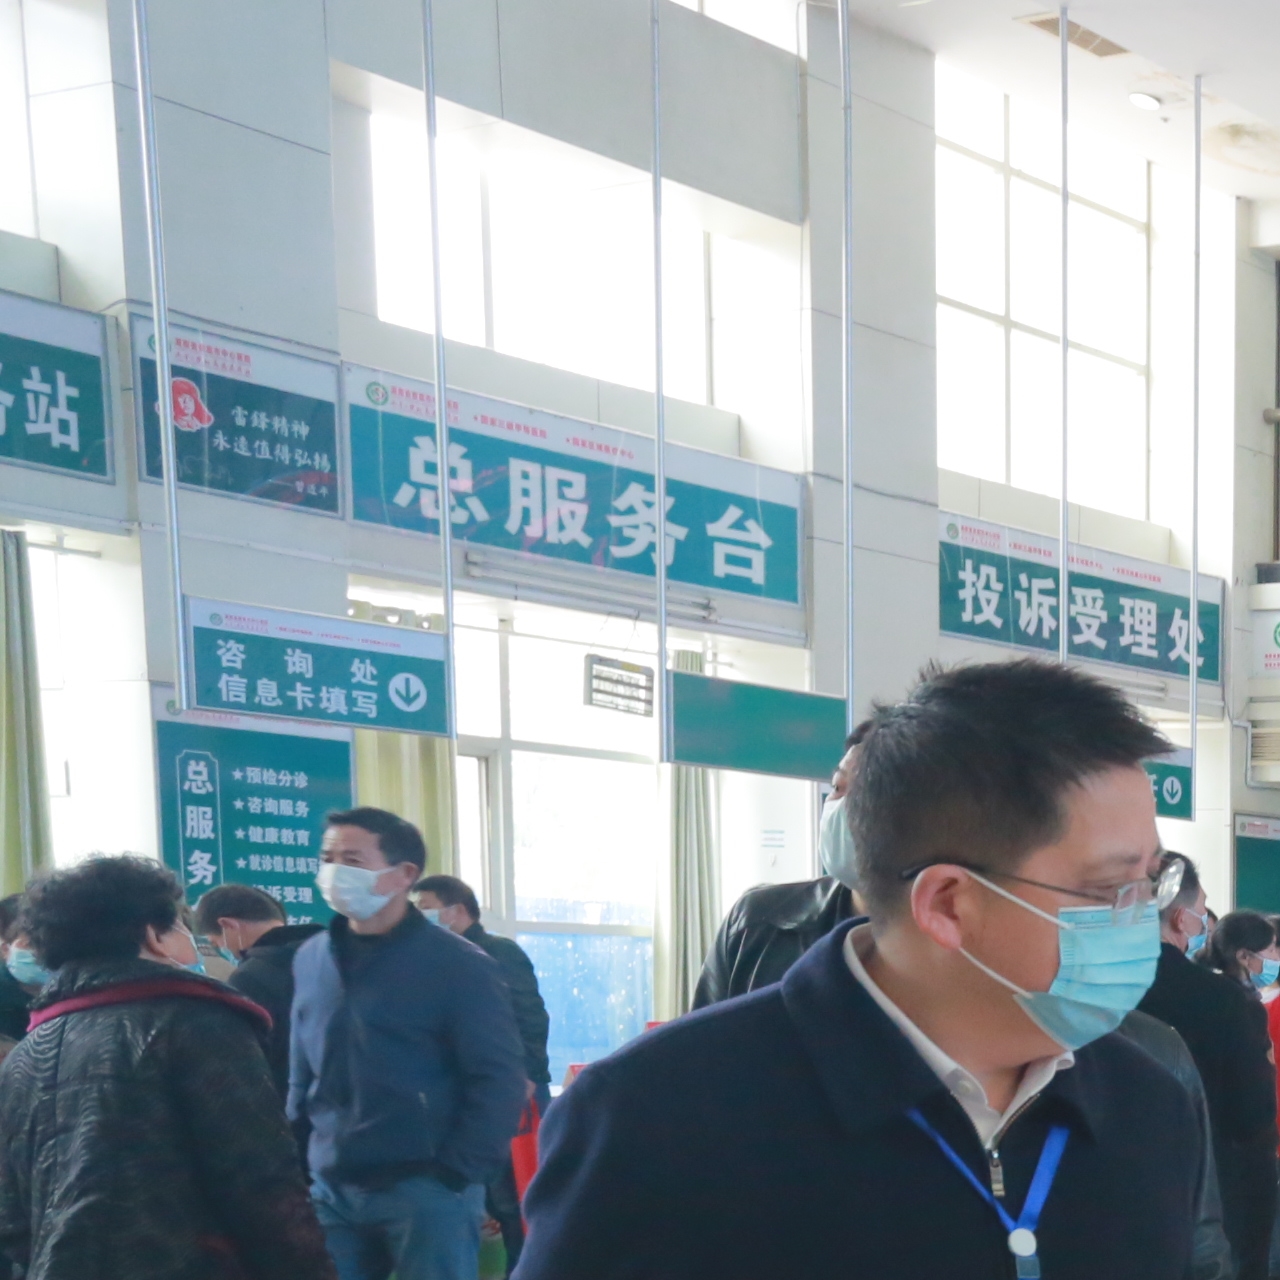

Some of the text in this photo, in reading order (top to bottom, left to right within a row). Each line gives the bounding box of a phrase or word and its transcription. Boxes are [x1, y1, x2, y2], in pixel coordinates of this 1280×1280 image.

[393, 435, 773, 585] 总服务台
[958, 558, 1205, 667] 投诉受理处
[216, 638, 379, 687] 咨询处
[217, 672, 379, 718] 信息卡填写
[246, 766, 309, 789] 预检分诊
[247, 798, 311, 818] 咨询服务
[184, 759, 218, 911] 总服务
[248, 826, 311, 847] 健康教育
[249, 853, 321, 875] 就诊信息填写
